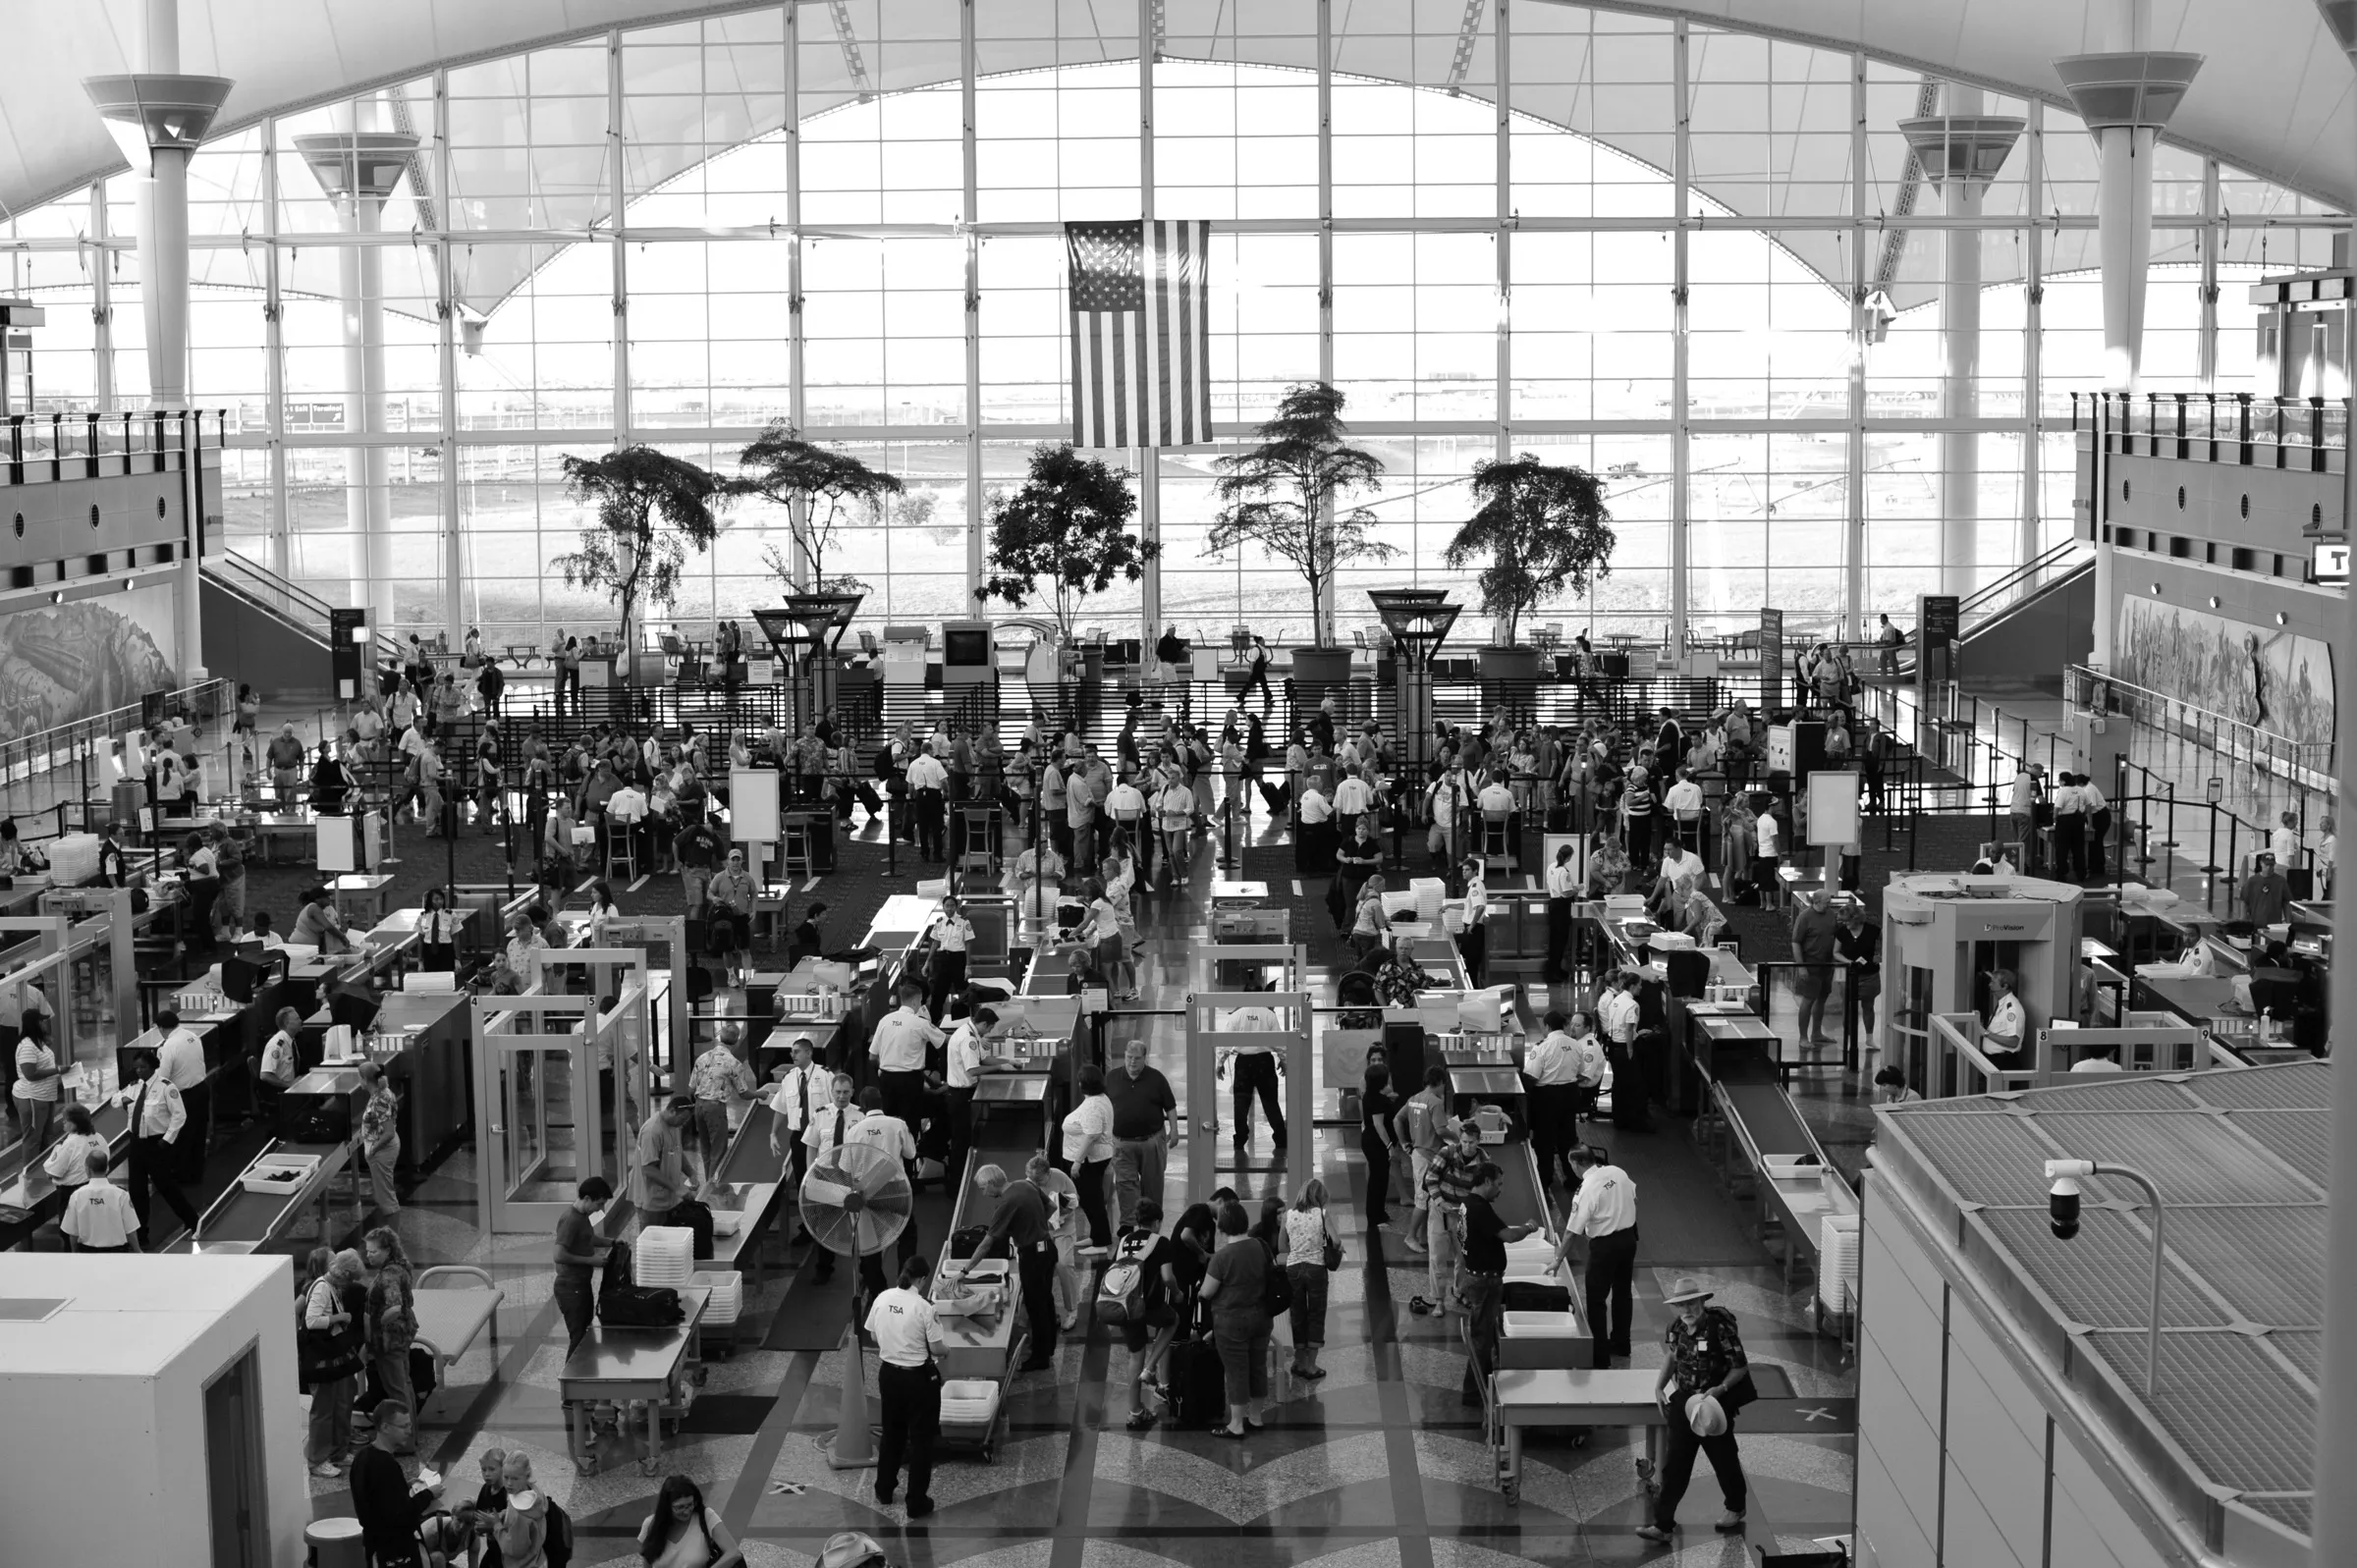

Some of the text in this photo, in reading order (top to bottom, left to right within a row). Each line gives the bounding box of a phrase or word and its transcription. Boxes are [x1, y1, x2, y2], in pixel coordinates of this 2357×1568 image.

[313, 404, 342, 412] Terminal
[588, 997, 595, 1005] 5
[1185, 994, 1192, 1003] 6
[1305, 993, 1311, 1001] 7
[2040, 1031, 2047, 1041] 8
[2202, 1030, 2209, 1039] 9
[866, 1128, 882, 1137] TSA
[88, 1139, 99, 1148] TSA
[1603, 1179, 1617, 1191] TSA
[888, 1305, 904, 1315] TSA
